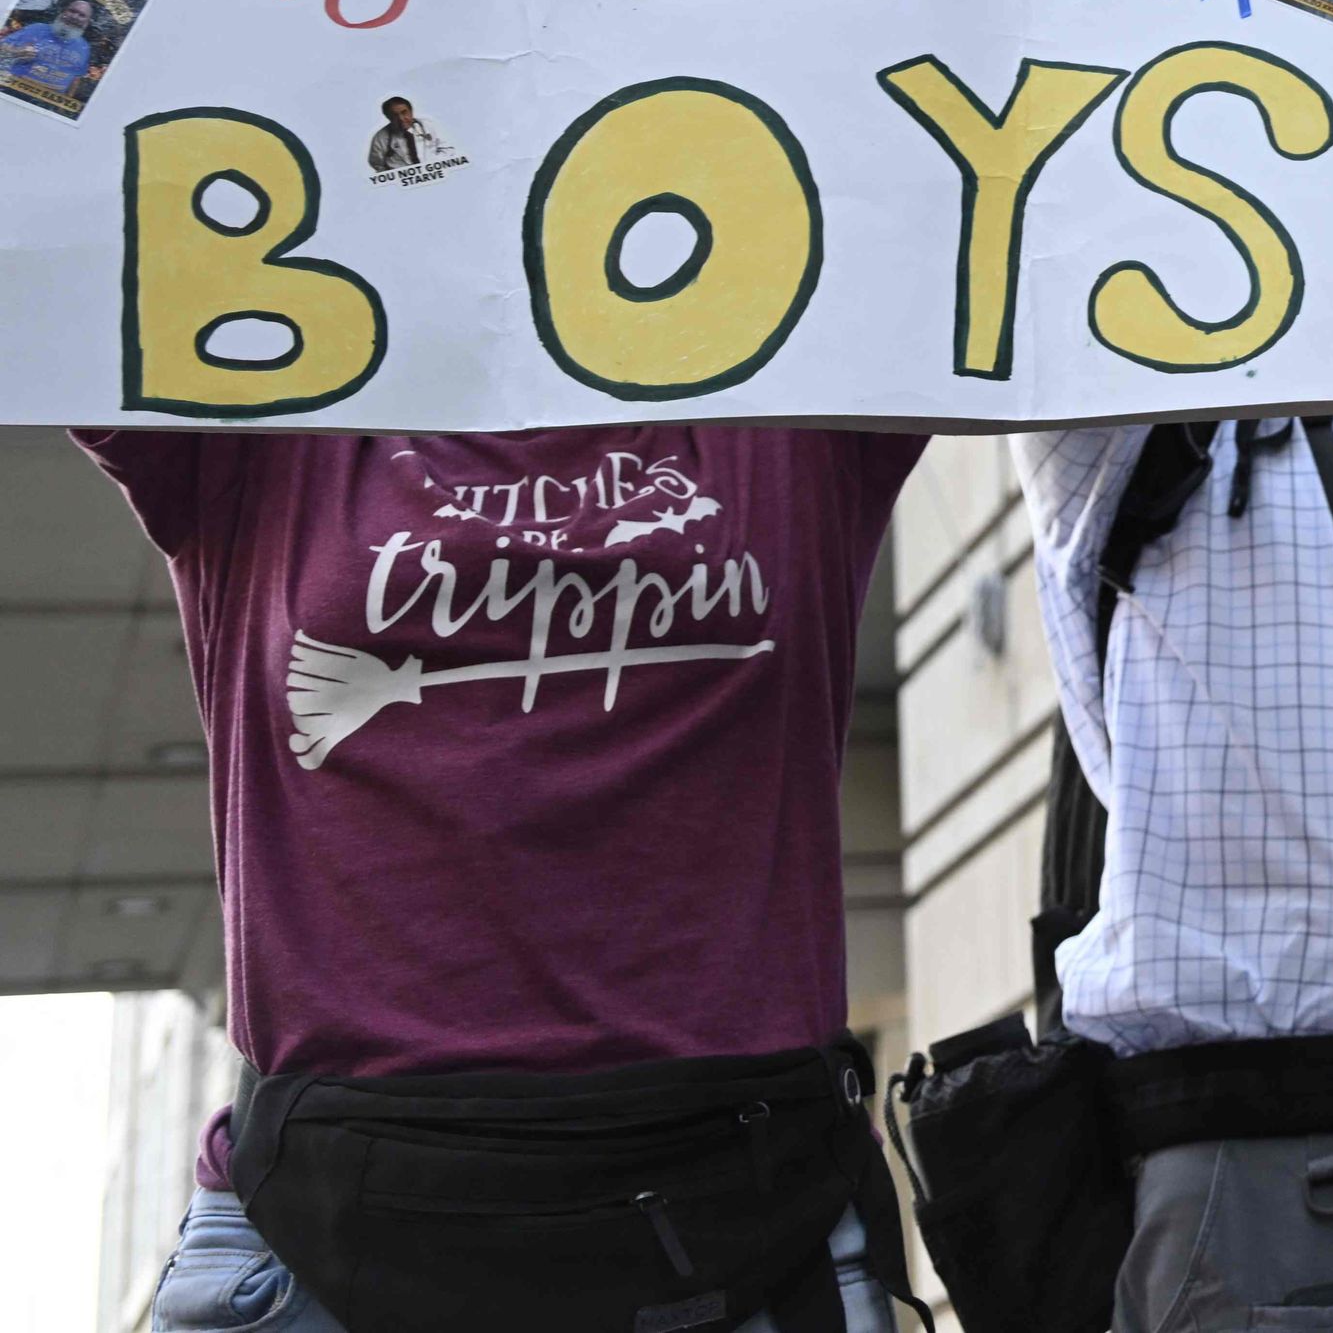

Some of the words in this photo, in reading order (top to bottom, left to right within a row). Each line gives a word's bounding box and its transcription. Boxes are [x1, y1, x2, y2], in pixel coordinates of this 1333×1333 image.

[369, 172, 395, 184] YOU
[398, 166, 422, 179] NOT
[425, 156, 470, 172] GONNA
[401, 171, 444, 186] STARVE
[424, 450, 698, 526] ITCHES
[365, 531, 770, 713] trippin
